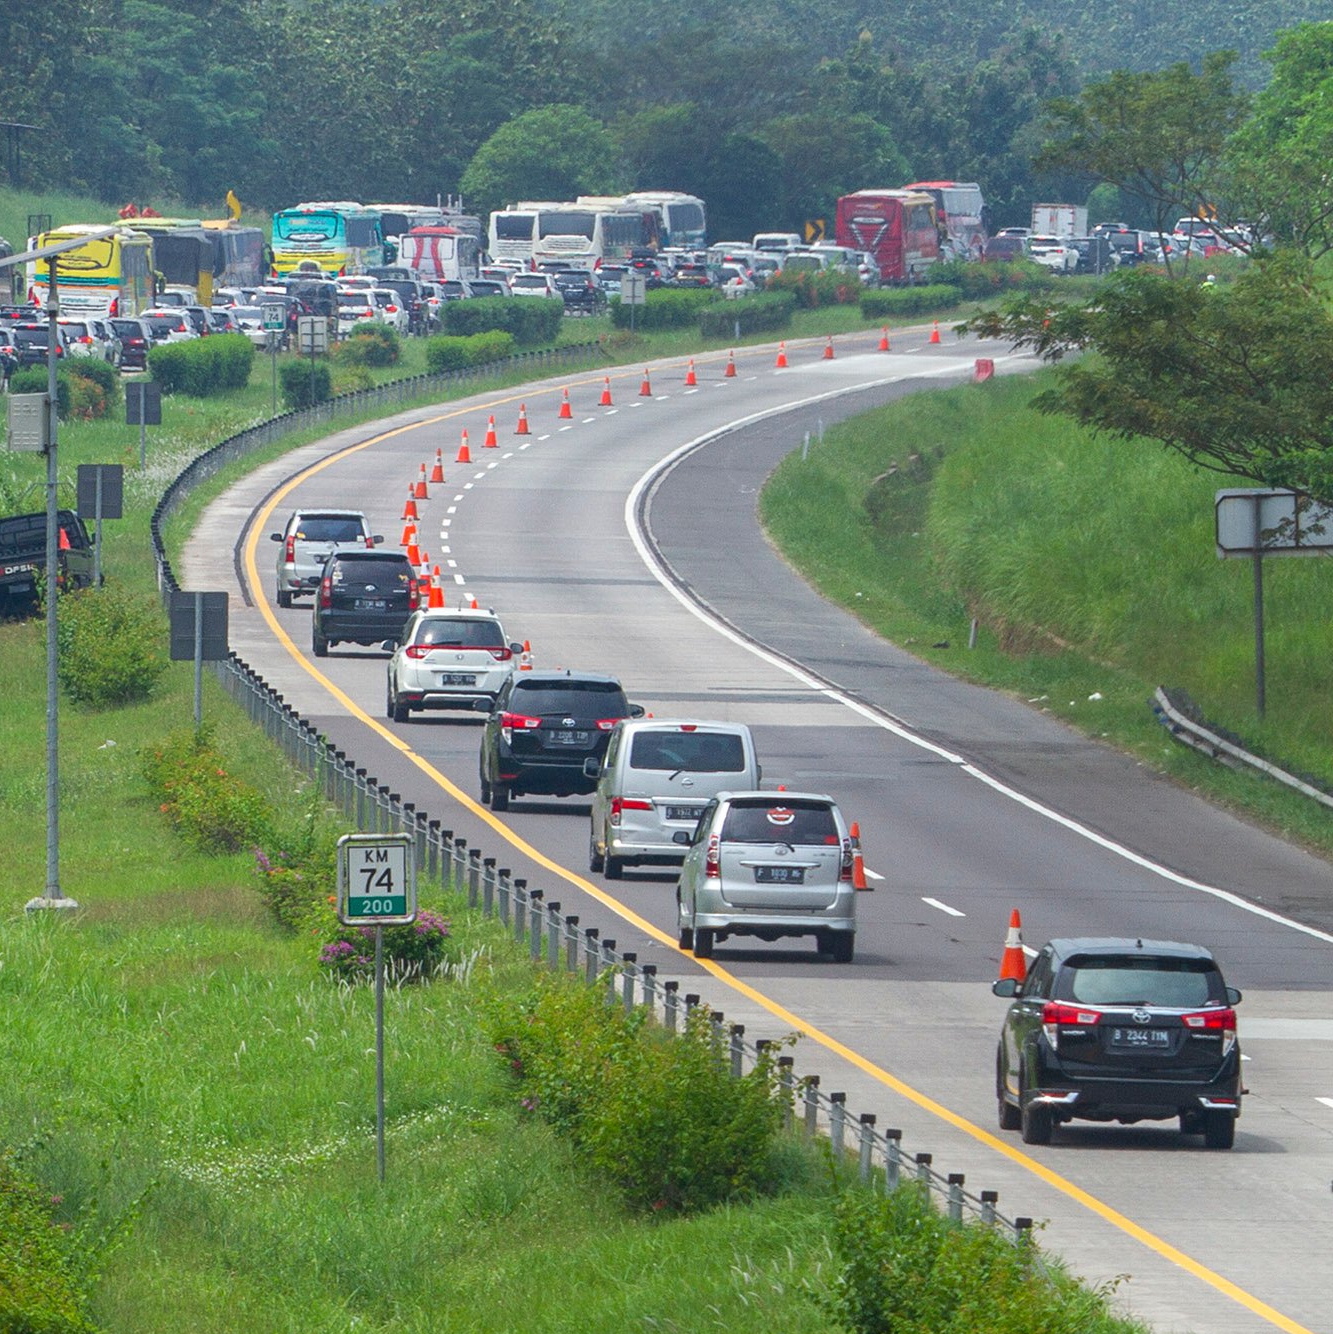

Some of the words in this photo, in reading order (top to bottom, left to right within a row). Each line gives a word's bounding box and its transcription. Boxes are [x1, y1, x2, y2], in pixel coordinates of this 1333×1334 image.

[365, 849, 389, 863] KM
[359, 867, 394, 894] 74
[361, 899, 393, 914] 200
